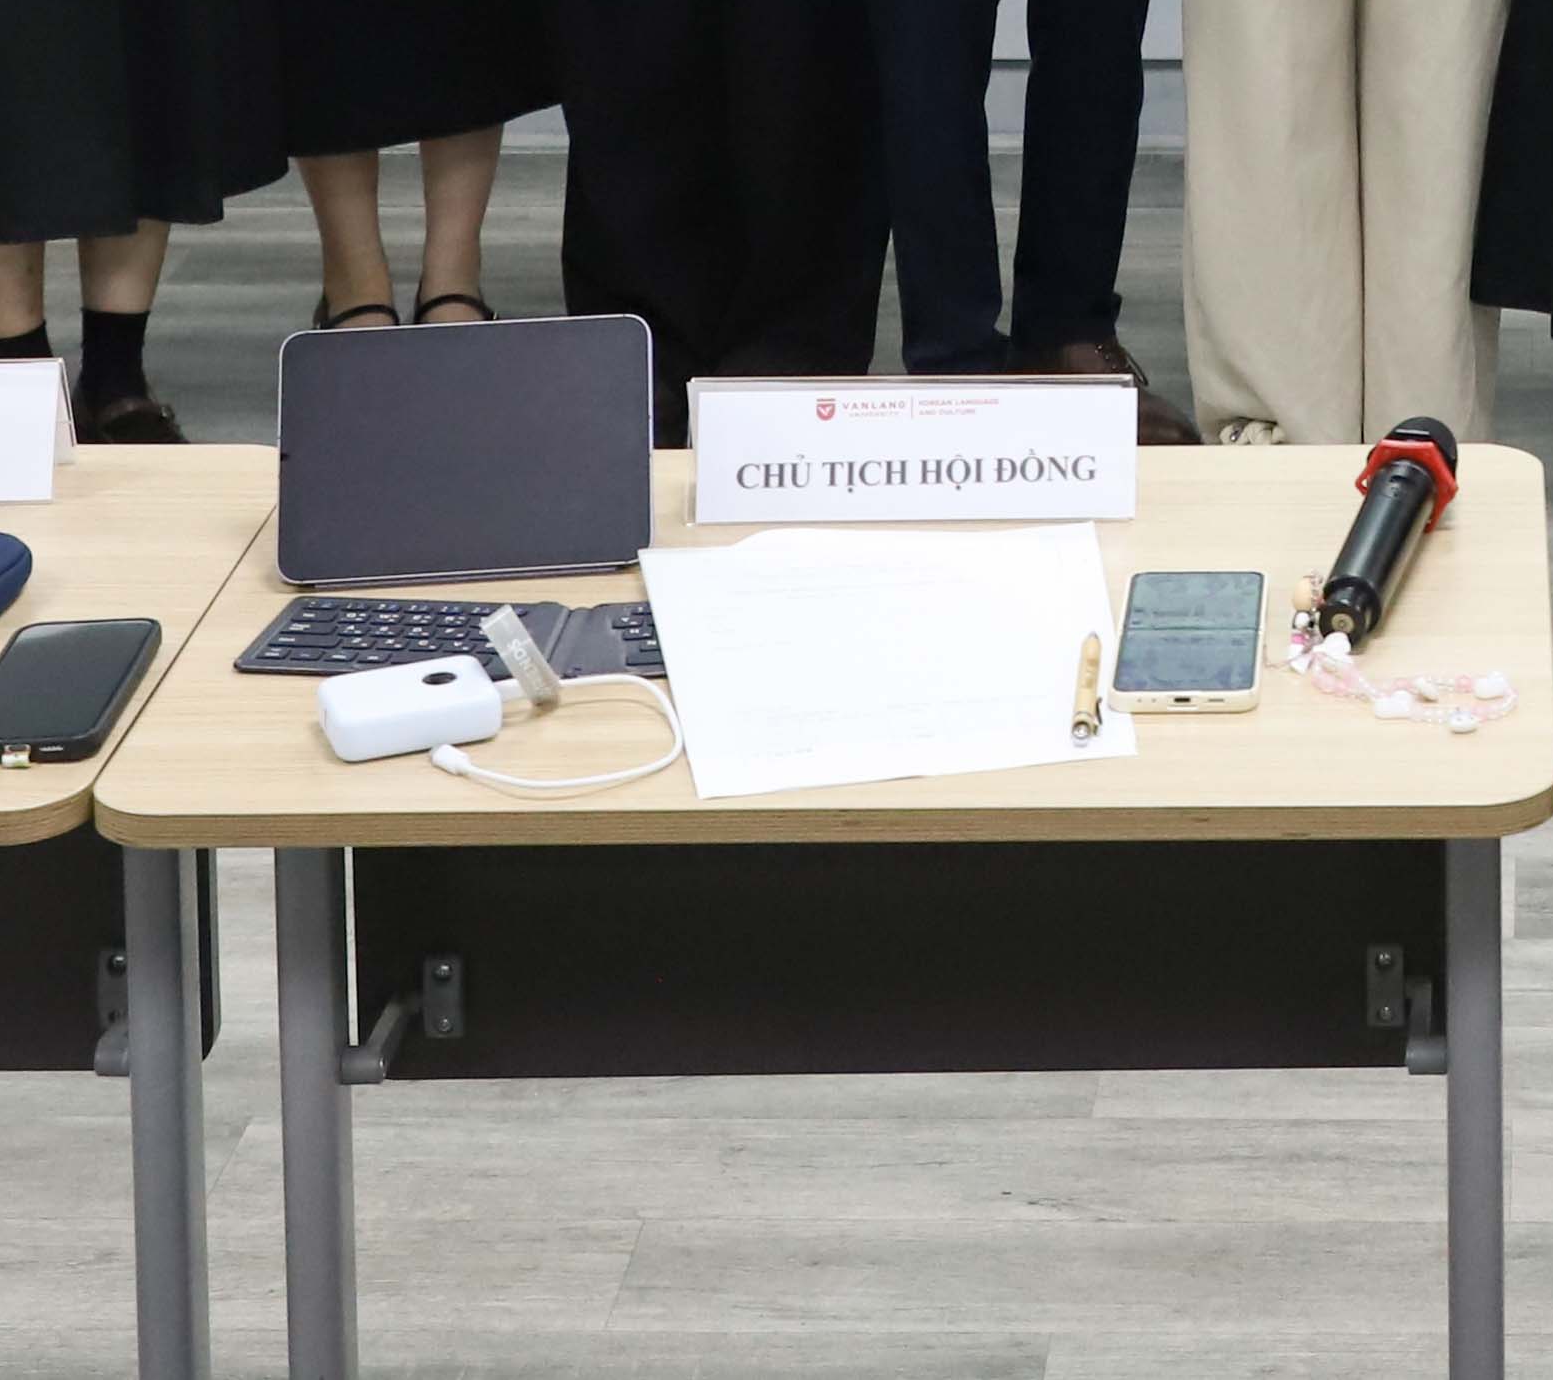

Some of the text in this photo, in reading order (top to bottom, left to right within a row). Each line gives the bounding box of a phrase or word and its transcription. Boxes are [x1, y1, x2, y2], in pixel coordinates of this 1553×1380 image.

[842, 400, 906, 410] VANLANG
[736, 454, 813, 490] CHỦ
[822, 458, 908, 492] TỊCH
[920, 452, 983, 490] HỘI
